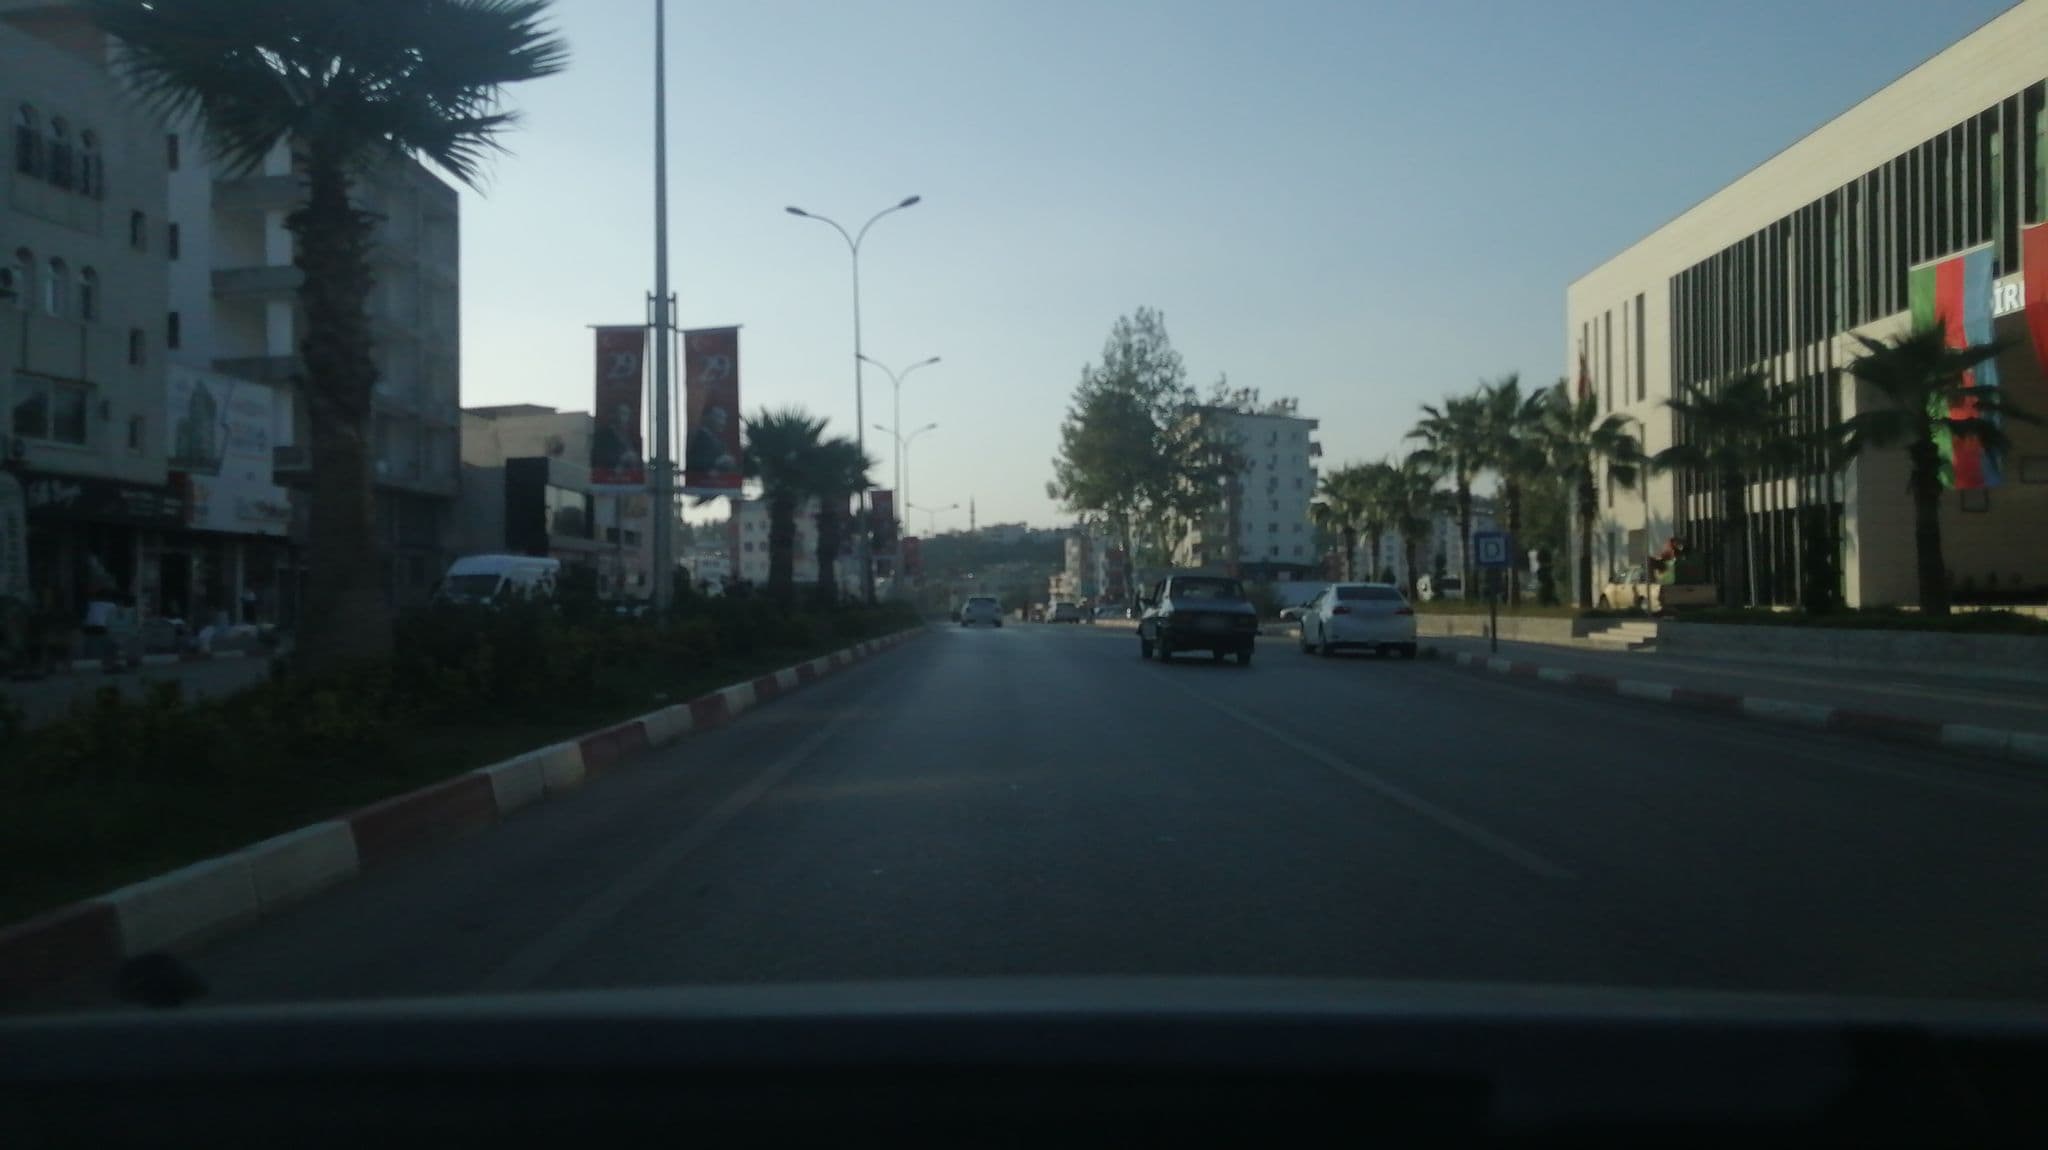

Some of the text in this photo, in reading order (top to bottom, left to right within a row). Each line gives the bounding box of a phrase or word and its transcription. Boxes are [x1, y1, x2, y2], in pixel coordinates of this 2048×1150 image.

[607, 351, 637, 379] 29
[697, 353, 731, 383] 29
[1484, 541, 1500, 560] D
